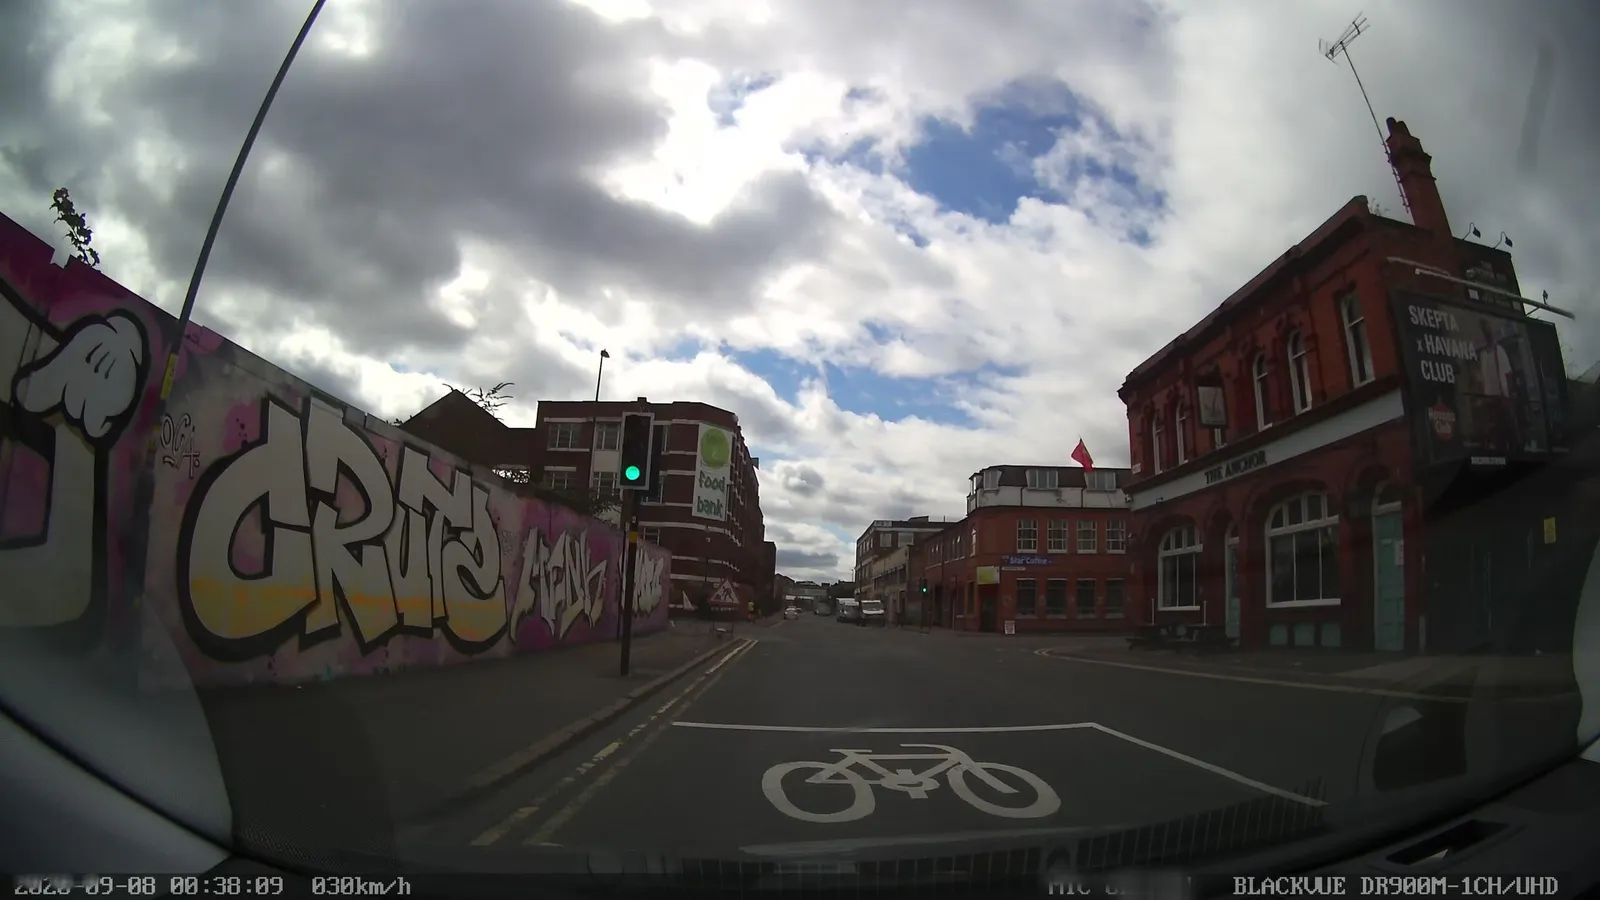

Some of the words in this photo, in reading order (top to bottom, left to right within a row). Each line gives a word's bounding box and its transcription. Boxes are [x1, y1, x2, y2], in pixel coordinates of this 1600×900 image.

[1408, 305, 1459, 332] SKEPTA
[1424, 333, 1478, 361] HAVANA
[1420, 360, 1455, 384] CLUB
[1204, 466, 1224, 484] THE
[1225, 450, 1268, 477] ANCHOR
[699, 470, 726, 494] food
[696, 495, 724, 518] bank
